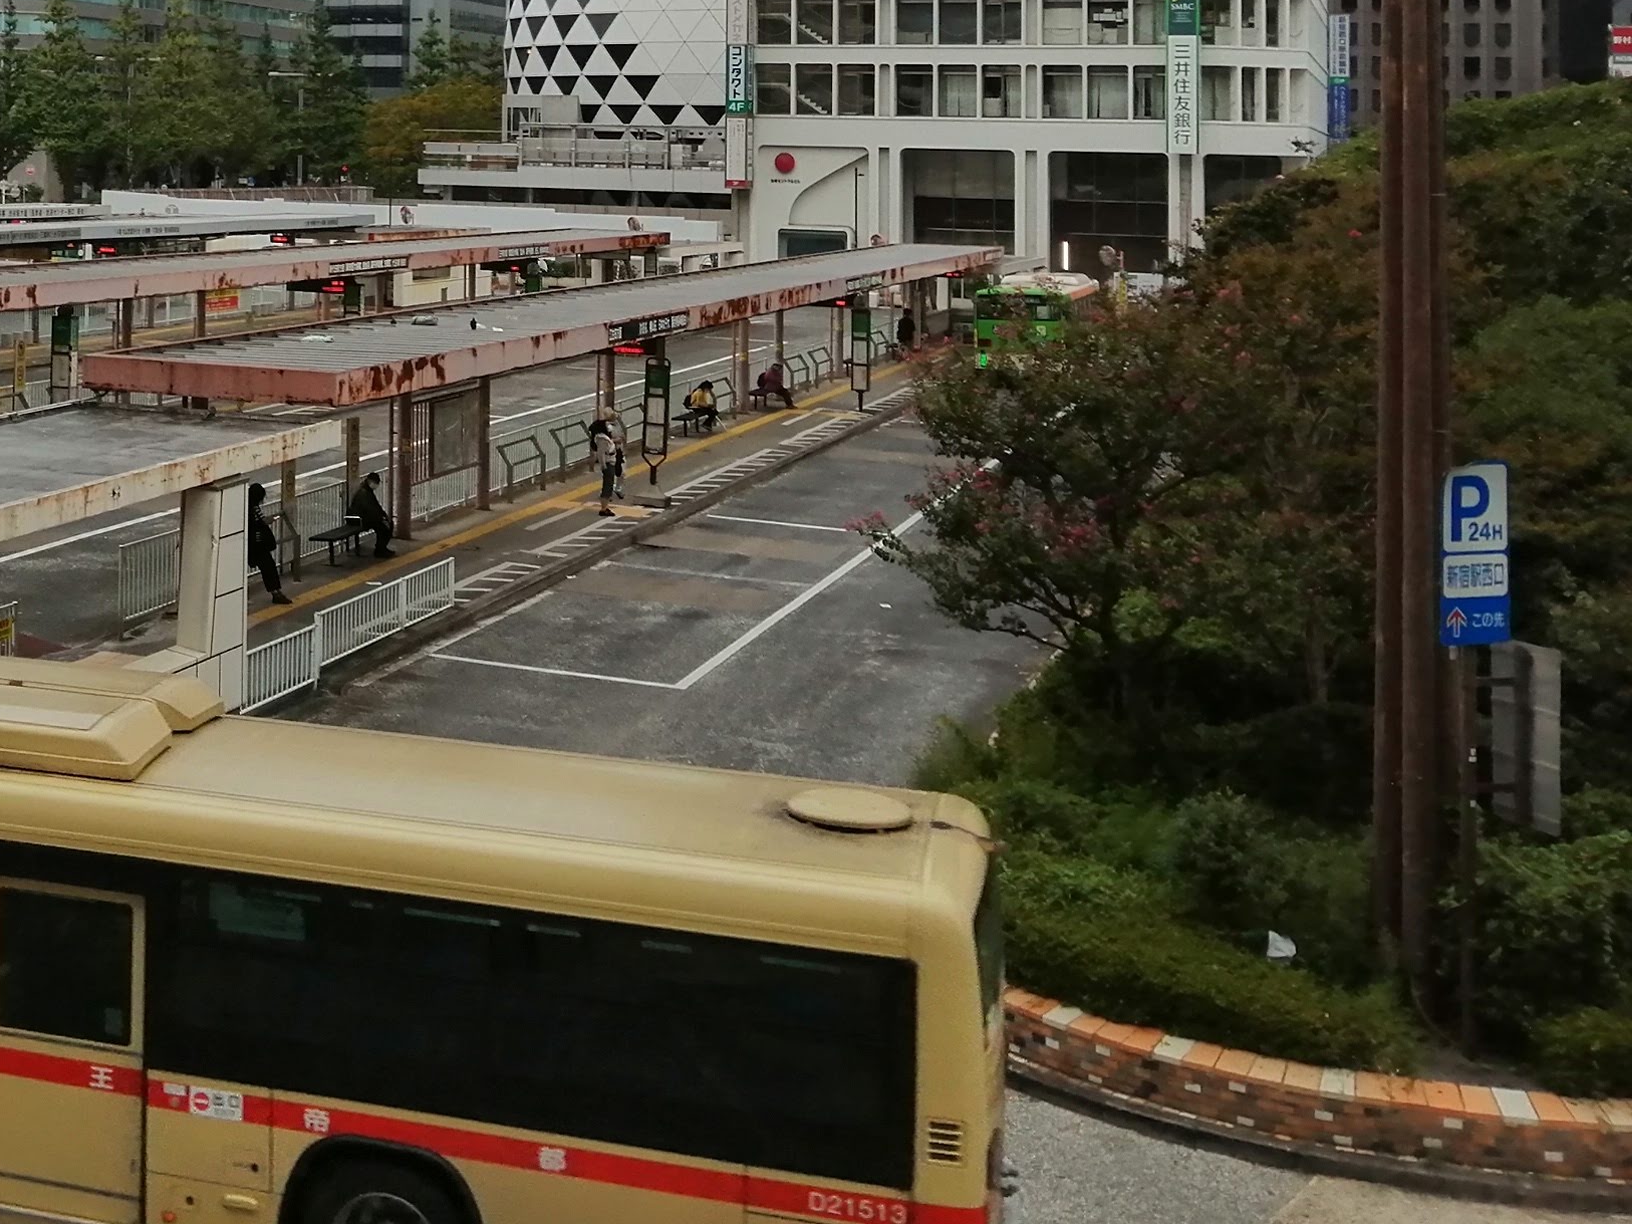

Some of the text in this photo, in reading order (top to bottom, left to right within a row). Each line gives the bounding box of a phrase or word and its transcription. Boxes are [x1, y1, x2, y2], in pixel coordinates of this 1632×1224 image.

[1171, 3, 1195, 11] SMBC
[731, 46, 742, 99] コンタクト
[728, 102, 745, 112] 4F
[1174, 44, 1191, 145] 三井住友銀行
[1451, 475, 1503, 542] P 24H
[1447, 563, 1505, 589] 新宿駅西口
[1472, 611, 1505, 628] この先
[89, 1065, 114, 1090] 王
[808, 1191, 908, 1224] D21513
